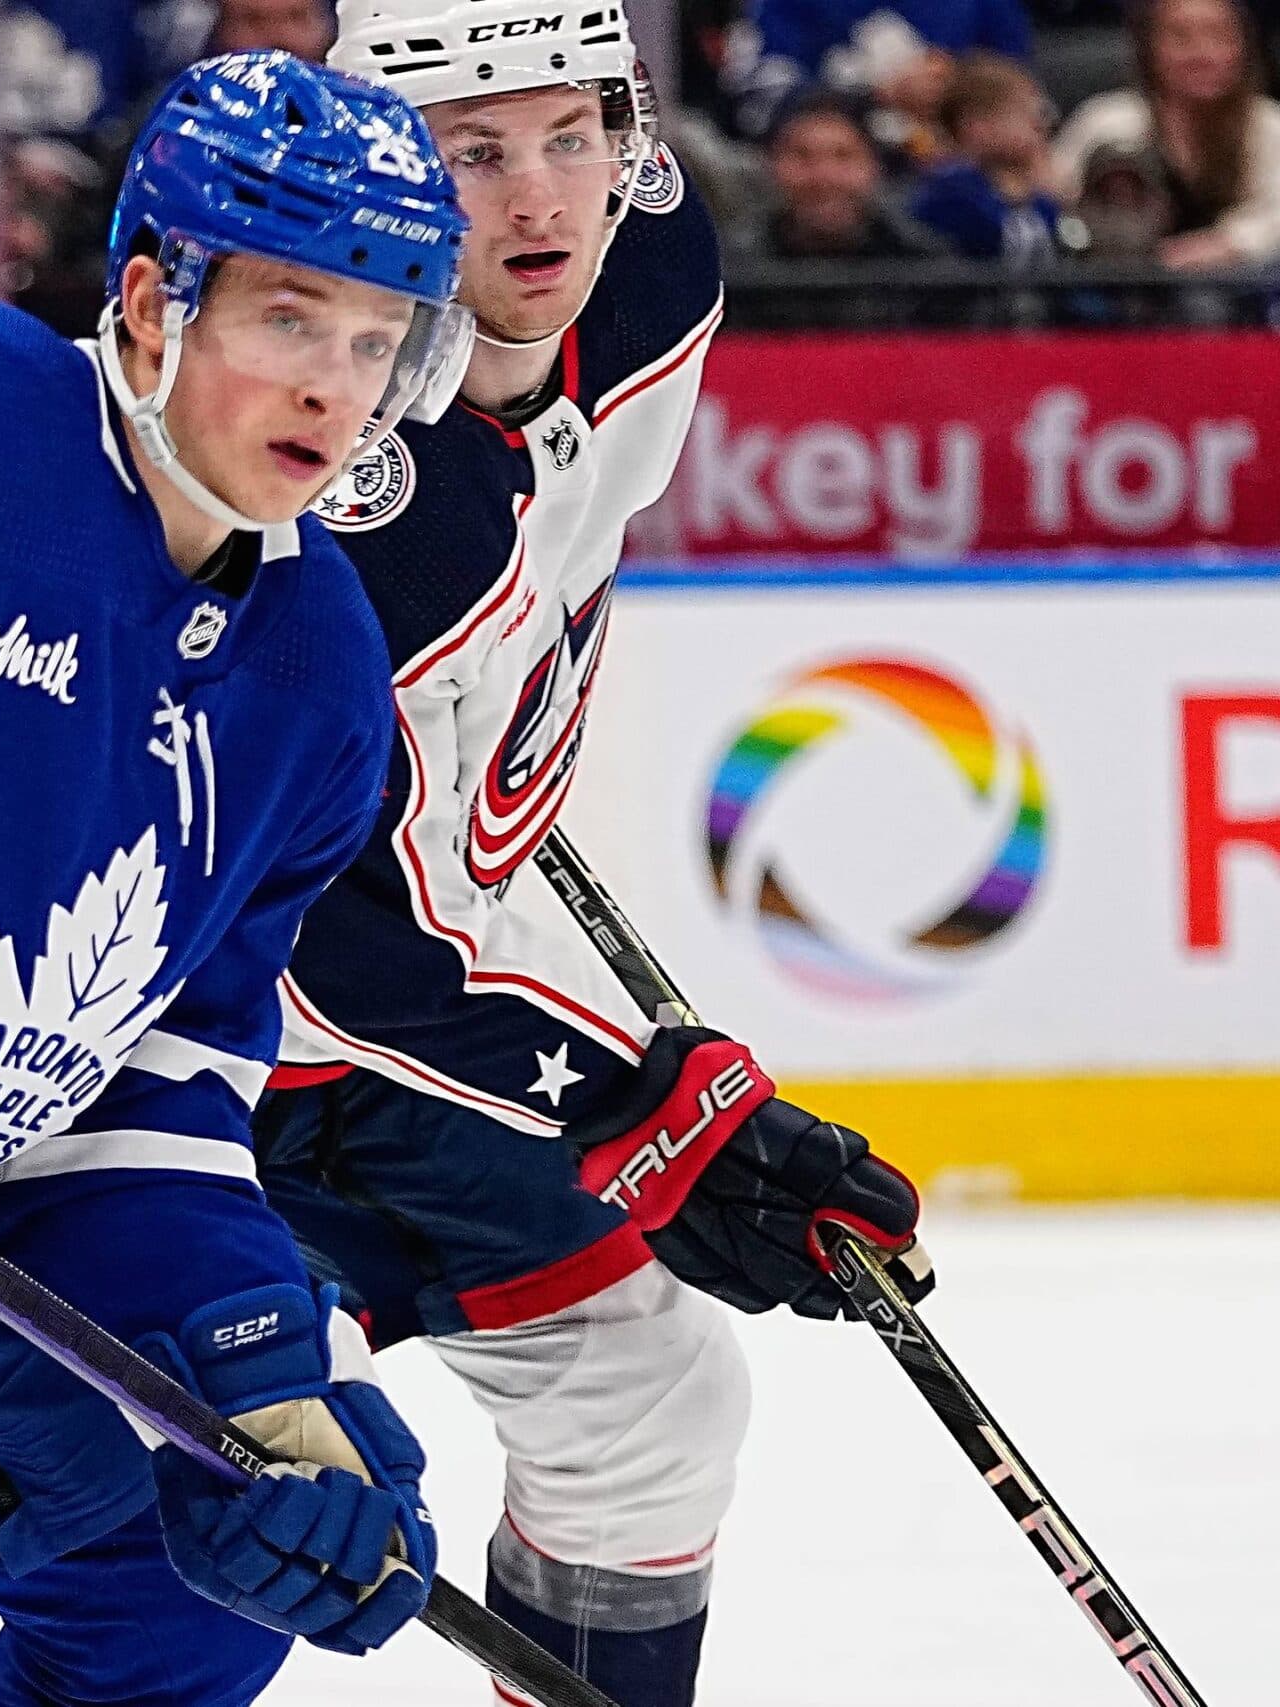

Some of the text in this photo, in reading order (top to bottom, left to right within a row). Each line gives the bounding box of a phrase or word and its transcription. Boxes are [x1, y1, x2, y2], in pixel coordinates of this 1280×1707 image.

[467, 14, 564, 43] CCM
[351, 206, 442, 245] BAUER
[368, 454, 403, 513] JACKETS
[1020, 387, 1258, 535] for
[537, 842, 623, 958] TRUE
[599, 1059, 755, 1210] TRUE
[213, 1311, 279, 1343] CCM
[234, 1332, 264, 1347] PRO
[979, 1426, 1202, 1707] TRUE
